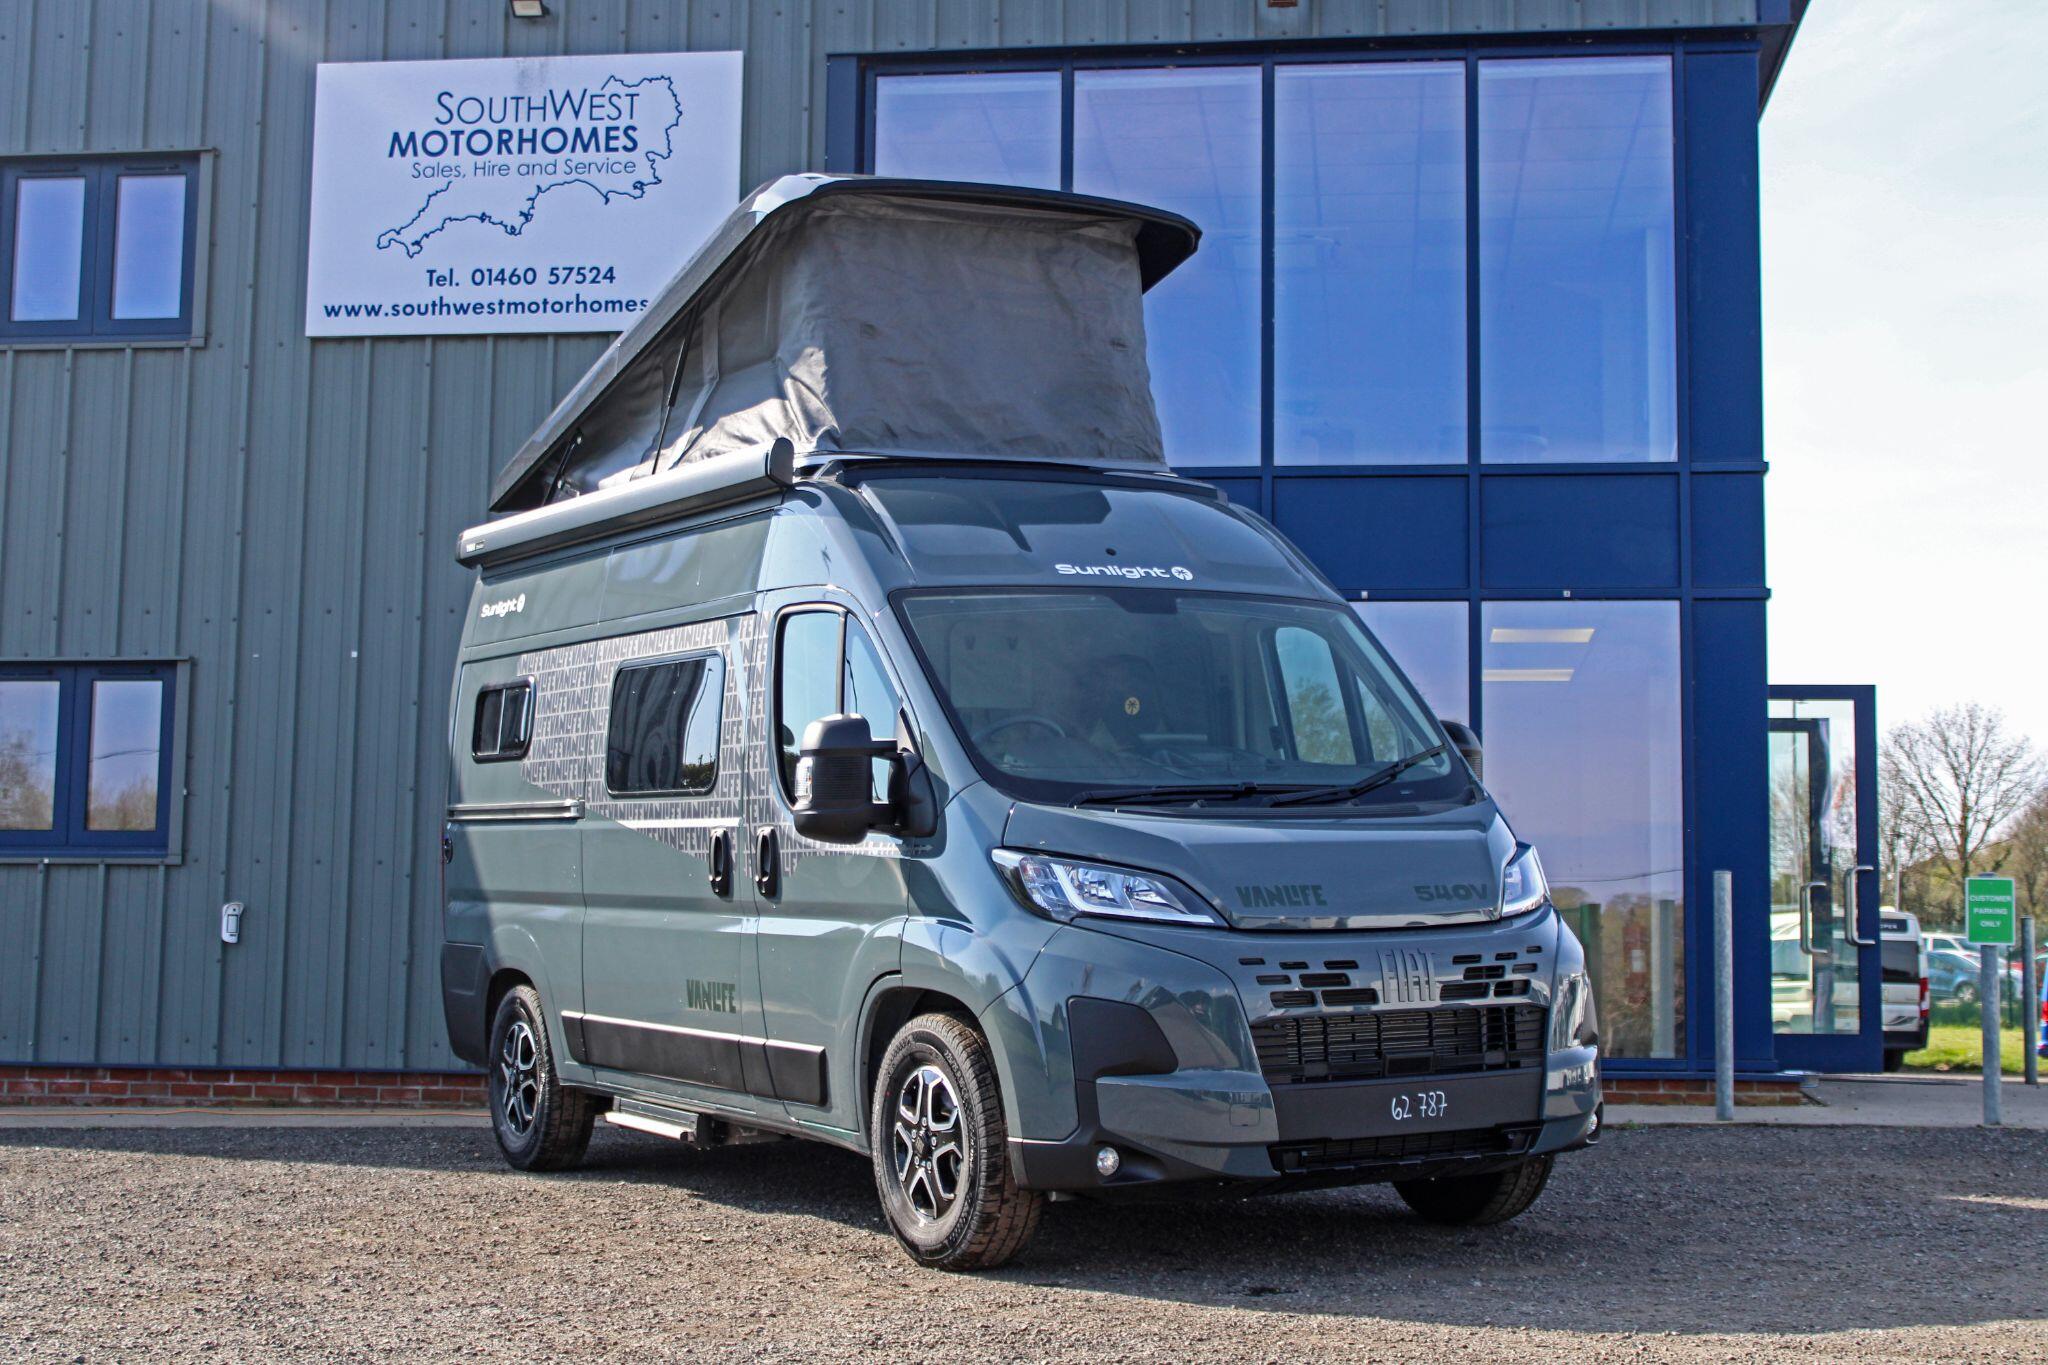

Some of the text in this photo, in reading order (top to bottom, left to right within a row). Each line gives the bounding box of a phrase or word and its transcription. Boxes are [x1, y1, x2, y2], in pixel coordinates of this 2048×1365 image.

[435, 88, 640, 125] SOUTHWEST
[388, 125, 638, 158] MOTORHOMES
[411, 158, 636, 179] Sales, Hire and Service
[426, 266, 616, 287] Tel. 01460 57524
[1055, 563, 1171, 579] Sunlight
[480, 598, 518, 618] Sunlight
[1235, 884, 1328, 908] VANLIFE
[1413, 884, 1488, 901] 540V
[1974, 907, 2008, 915] PARKING
[1980, 920, 2001, 928] ONLY
[1376, 947, 1438, 1004] FIAT
[686, 978, 737, 1014] VANLIFE
[1391, 1090, 1448, 1121] 62 787
